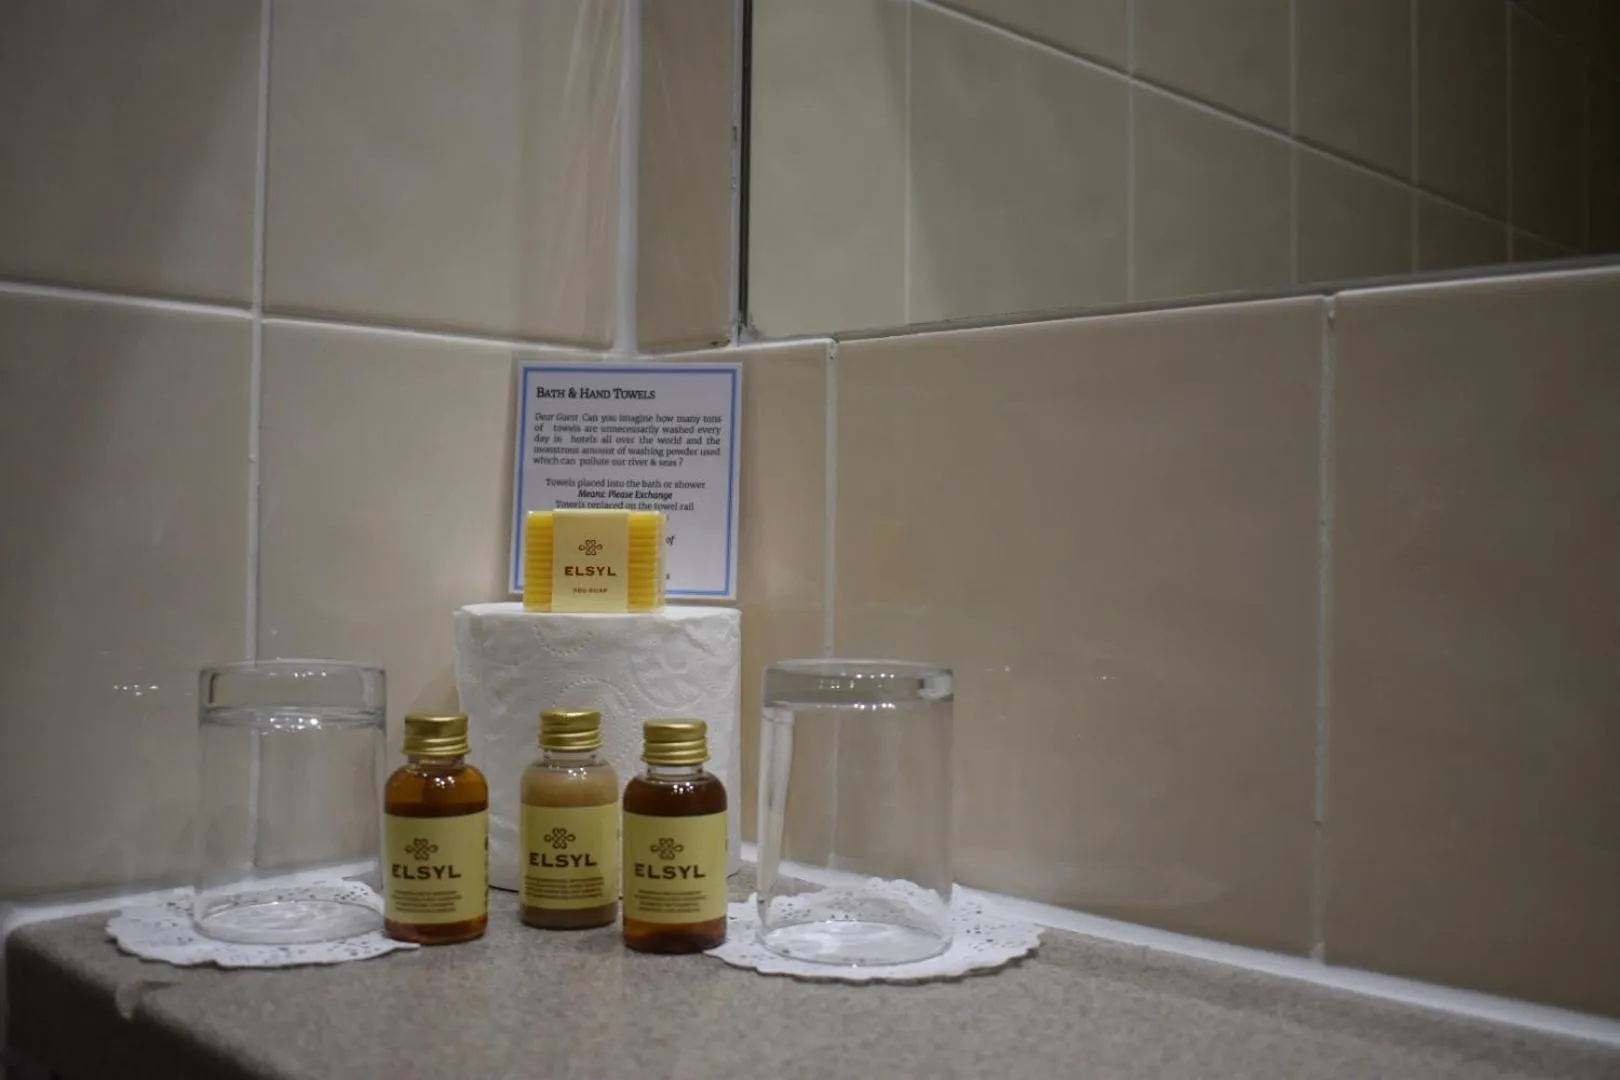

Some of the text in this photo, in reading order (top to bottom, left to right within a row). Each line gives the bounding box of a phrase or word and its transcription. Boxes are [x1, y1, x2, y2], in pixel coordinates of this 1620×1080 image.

[536, 386, 656, 400] BATH & HAND TOWELS
[535, 413, 554, 421] Dear
[582, 413, 598, 422] Can
[601, 415, 617, 423] you
[619, 414, 653, 424] imagine
[656, 414, 673, 422] how
[676, 415, 700, 423] many
[703, 415, 721, 423] tons
[534, 423, 543, 432] of
[553, 424, 581, 432] towels
[601, 424, 659, 435] unnecessarily
[662, 425, 694, 434] washed
[697, 427, 721, 435] every
[534, 434, 550, 443] day
[553, 434, 562, 443] in
[570, 434, 597, 443] hotels
[601, 434, 612, 444] all
[639, 435, 653, 444] the
[657, 435, 682, 444] world
[686, 436, 702, 445] and
[706, 436, 720, 445] the
[617, 445, 627, 455] of
[628, 447, 664, 457] washing
[666, 447, 698, 457] powder
[700, 448, 720, 456] used
[533, 456, 559, 465] which
[579, 456, 609, 467] pollute
[628, 458, 648, 467] river
[545, 478, 576, 487] Towels
[577, 478, 605, 488] placed
[607, 478, 624, 487] into
[626, 479, 641, 488] the
[642, 479, 661, 488] bath
[674, 480, 706, 489] shower
[607, 489, 633, 499] Please
[635, 490, 673, 501] Exchange
[555, 500, 585, 509] Towels
[638, 502, 652, 511] the
[654, 502, 678, 511] towel
[679, 502, 694, 511] rail
[665, 535, 675, 546] of
[564, 566, 616, 576] ELSYL
[527, 851, 597, 868] ELSYL
[391, 864, 461, 880] ELSYL
[635, 863, 706, 880] ELSYL
